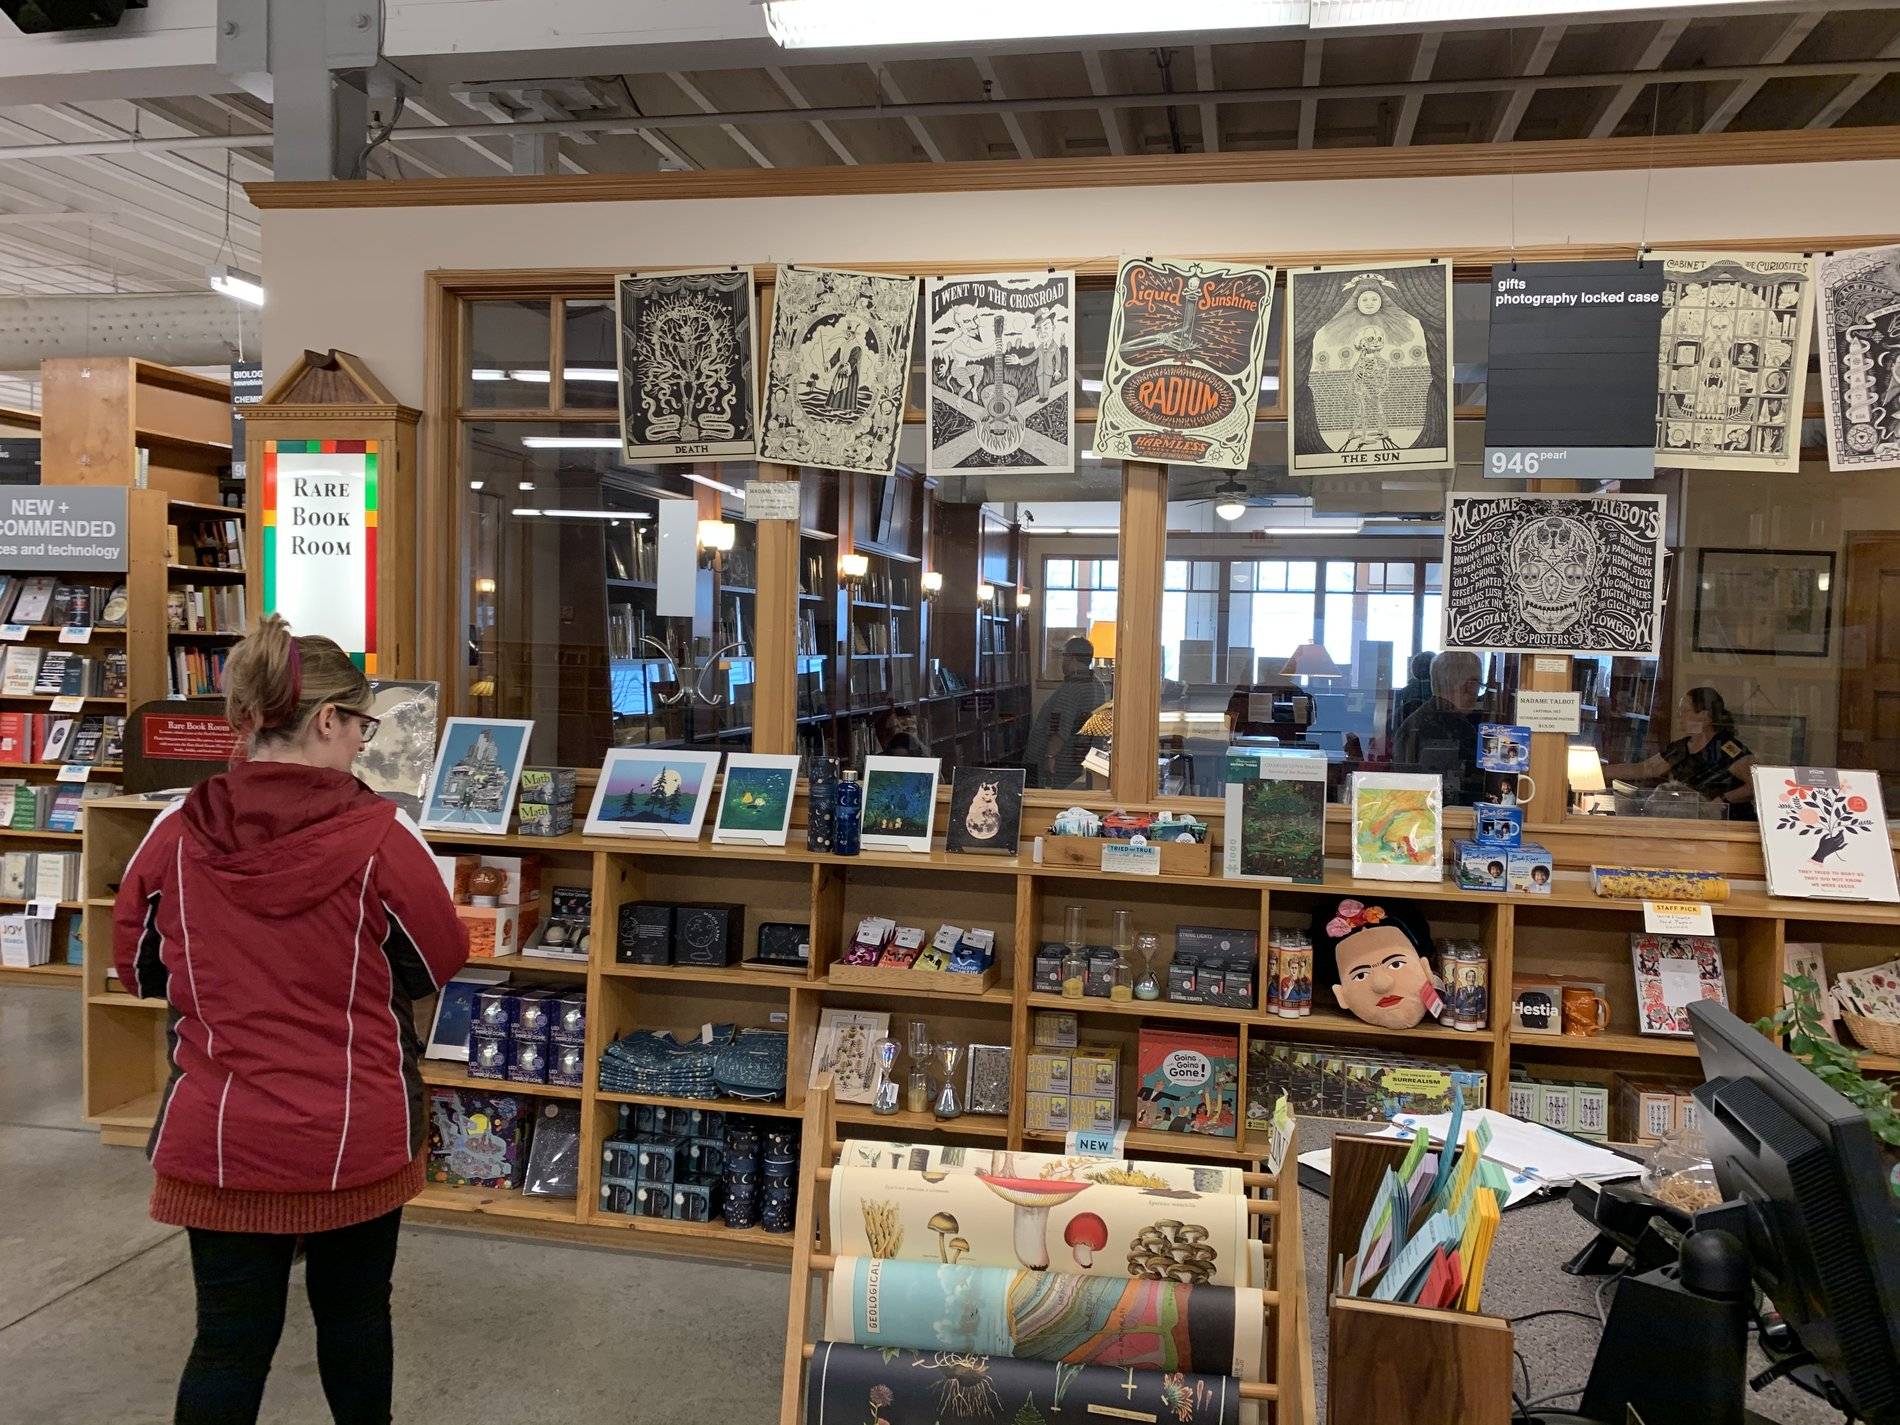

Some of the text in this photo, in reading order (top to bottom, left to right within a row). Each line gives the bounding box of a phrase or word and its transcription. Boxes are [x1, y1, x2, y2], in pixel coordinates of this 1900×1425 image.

[1666, 259, 1707, 270] CABINET
[1125, 267, 1257, 312] Liquid Sunshine
[1498, 278, 1526, 292] gifts
[934, 282, 1065, 312] I WENT TO THE CROSSROAD
[1495, 291, 1659, 306] photography locked case
[1138, 376, 1220, 417] RADIUM
[674, 445, 709, 454] DEATH
[1135, 436, 1208, 452] HARMLESS
[1341, 452, 1400, 464] THE SUN
[1491, 450, 1567, 474] 946 pearl
[11, 499, 70, 516] NEW +
[1450, 497, 1661, 539] MADAME TALBOT'S
[20, 543, 45, 556] and
[48, 544, 120, 560] technology
[1454, 531, 1504, 553] DESIGNED &
[1620, 533, 1653, 555] BEAUTIFUL
[1454, 544, 1496, 566] DRAWN HAND
[1463, 561, 1476, 574] PEN
[1483, 552, 1497, 566] INK
[1612, 544, 1653, 567] PARCHMENT
[1612, 554, 1653, 579] HEAVY STOCK
[1452, 577, 1502, 597] OFFSET PRINTED
[1607, 566, 1652, 589] ABSOLUTELY
[1452, 588, 1503, 606] GENEROUS LUSH
[1614, 578, 1653, 600] COMPUTERS
[1469, 598, 1505, 612] BLACK INK
[1607, 599, 1637, 616] GICLEE
[1445, 607, 1657, 650] VICTORIAN LOWBROW
[1529, 634, 1569, 645] POSTERS
[168, 721, 230, 731] Rare Book Room
[523, 773, 550, 785] Math
[1512, 1001, 1559, 1017] Hestia
[1080, 1139, 1108, 1151] NEW
[869, 1261, 881, 1329] GEOLOGICAL
